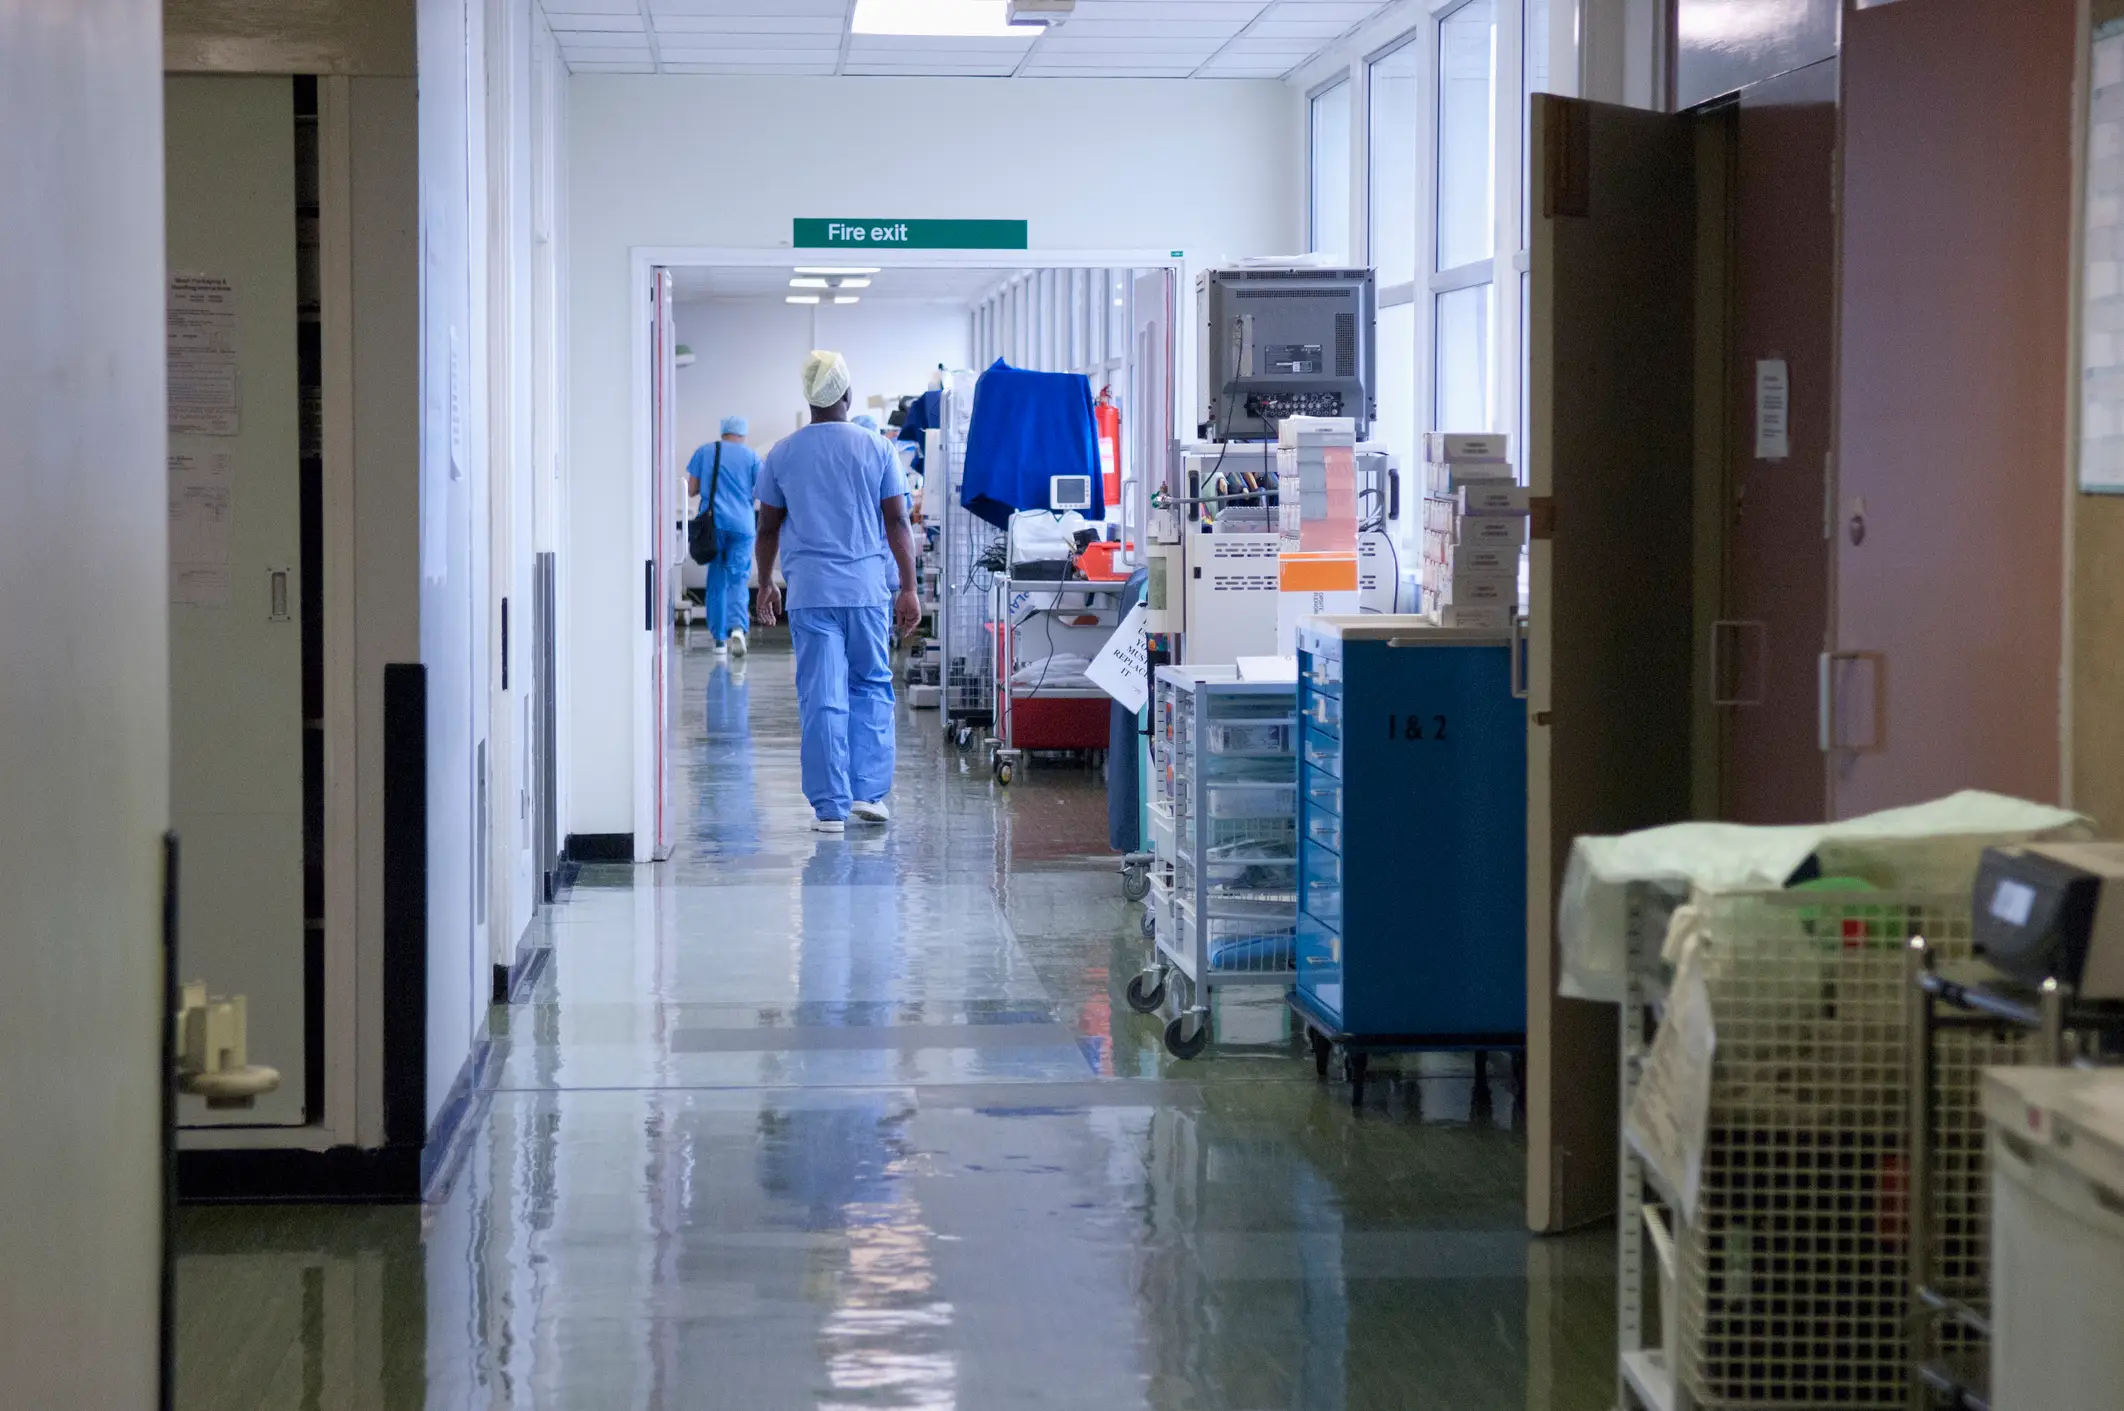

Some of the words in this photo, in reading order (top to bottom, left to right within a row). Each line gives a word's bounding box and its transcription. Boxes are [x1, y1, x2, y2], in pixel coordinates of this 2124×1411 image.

[828, 223, 866, 241] Fire
[870, 223, 908, 241] exit
[1136, 639, 1148, 652] YO
[1120, 668, 1132, 678] IT
[1405, 714, 1425, 741] &
[1433, 714, 1447, 740] 2
